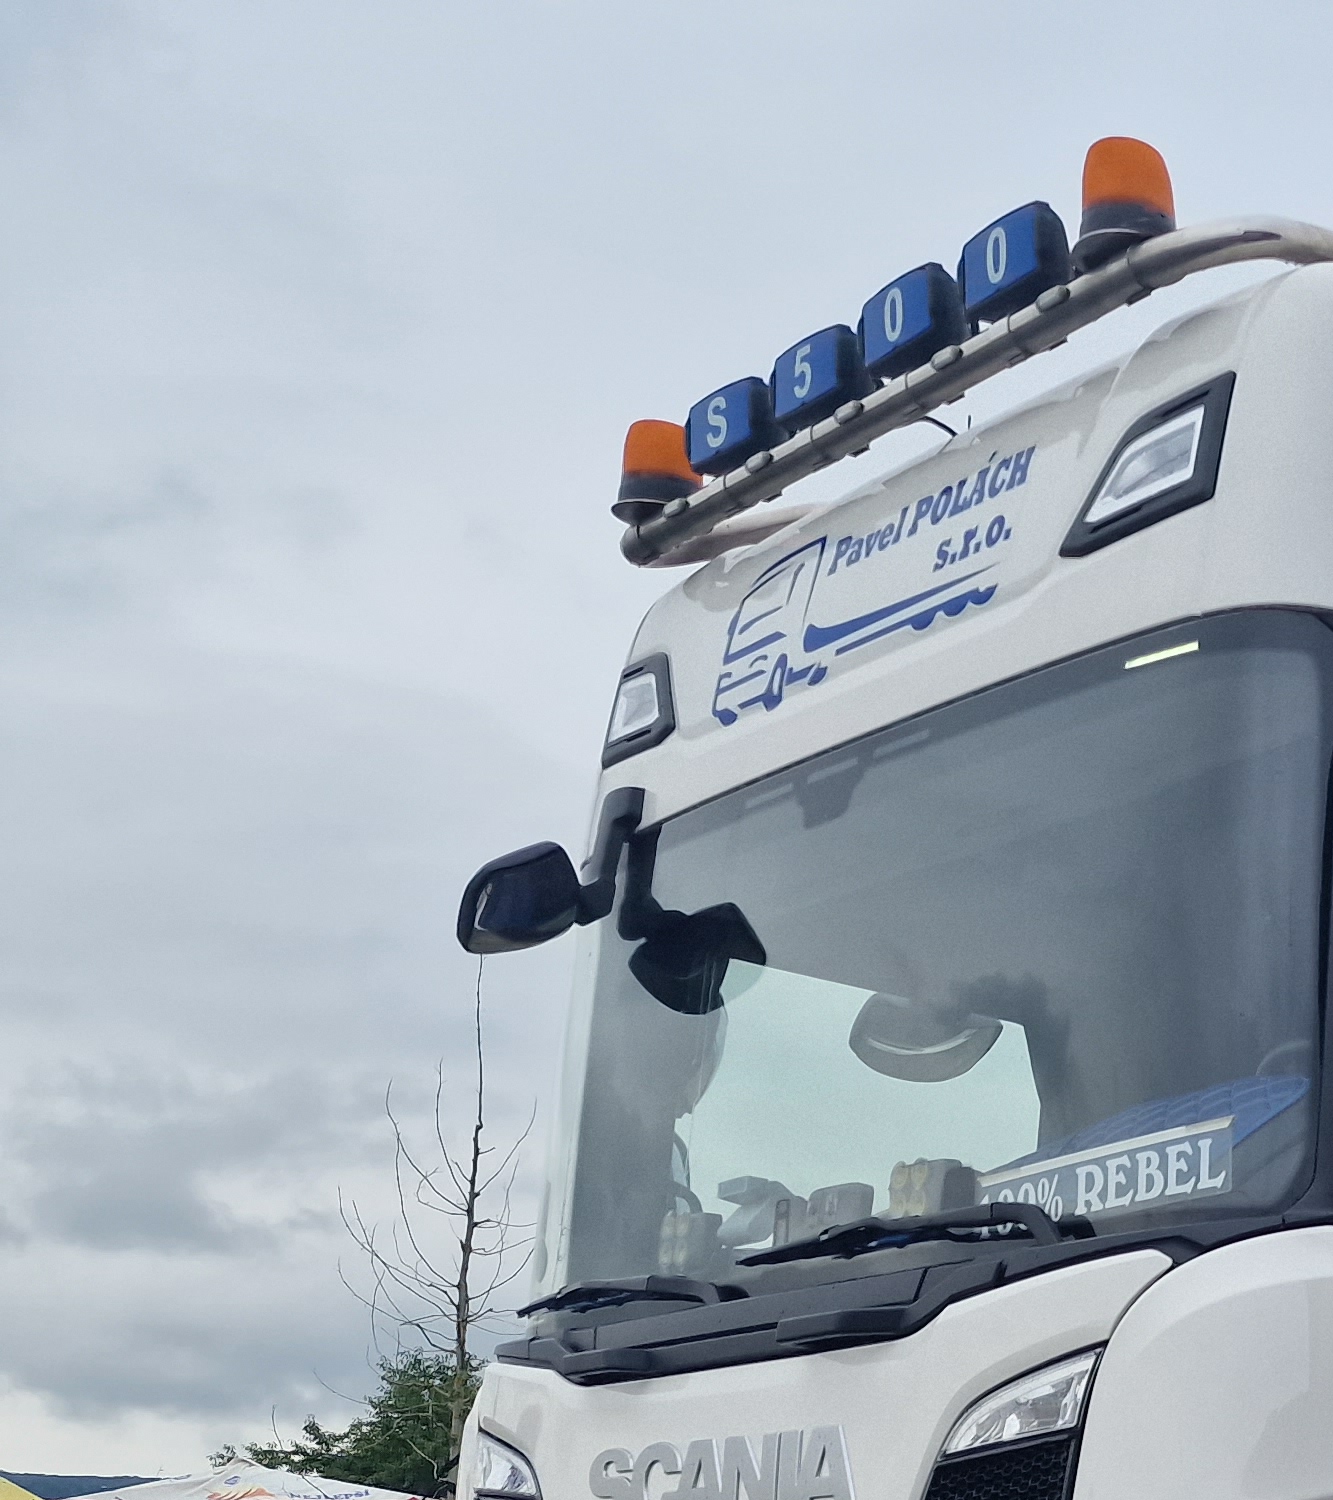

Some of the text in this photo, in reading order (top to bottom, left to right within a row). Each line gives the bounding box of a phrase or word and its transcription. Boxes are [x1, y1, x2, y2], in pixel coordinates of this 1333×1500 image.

[707, 227, 1007, 449] S 5 0 0
[828, 444, 1037, 575] Pavel POLÁCH
[933, 515, 1013, 572] s.r.o.
[1074, 1137, 1229, 1216] REBEL
